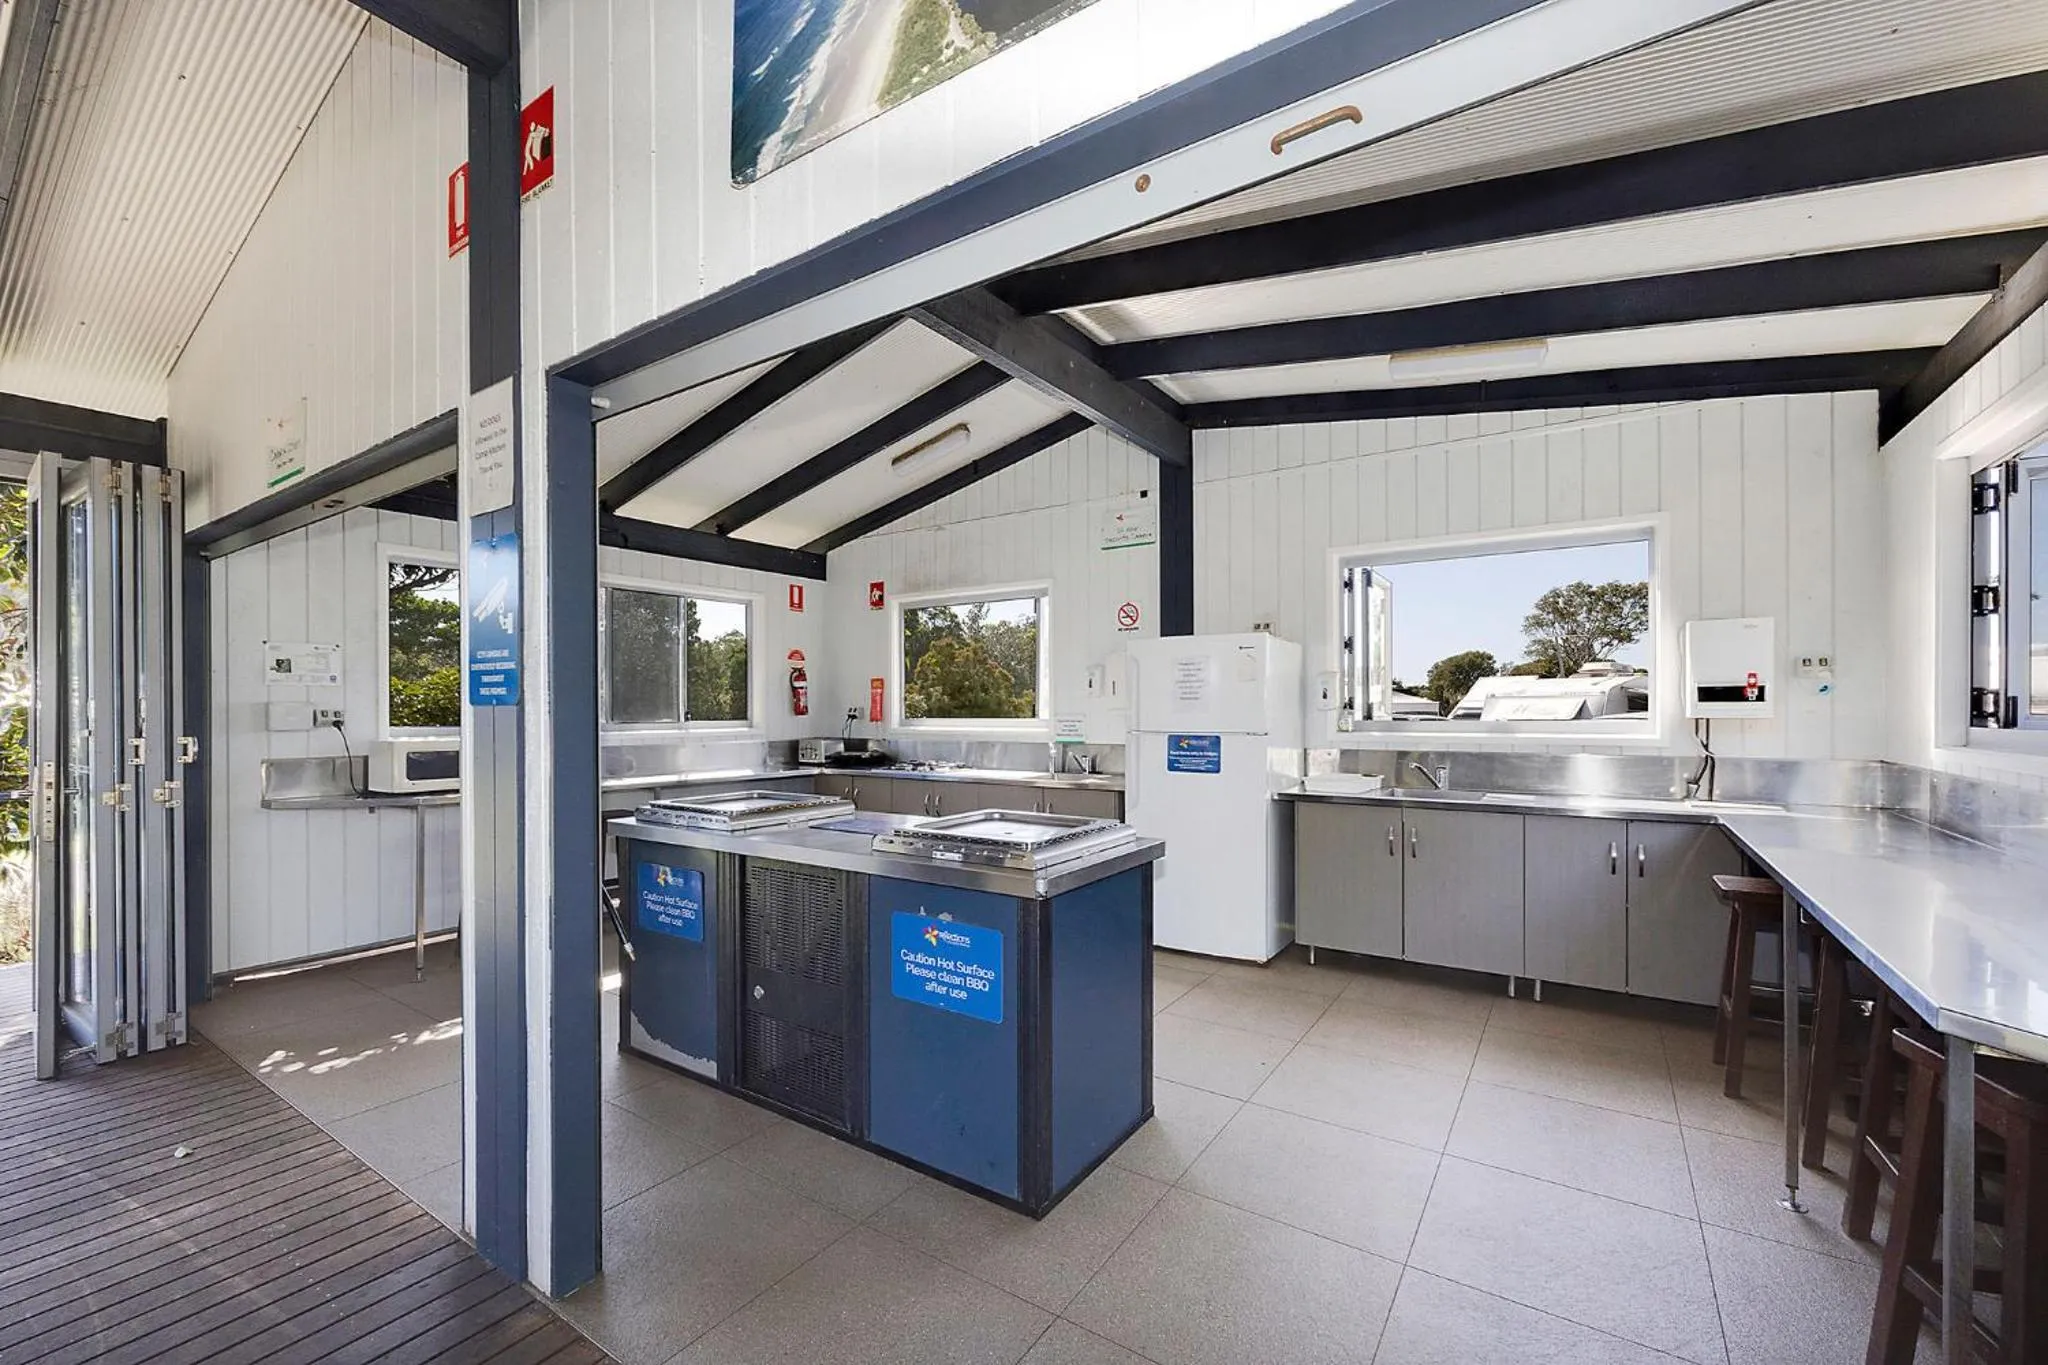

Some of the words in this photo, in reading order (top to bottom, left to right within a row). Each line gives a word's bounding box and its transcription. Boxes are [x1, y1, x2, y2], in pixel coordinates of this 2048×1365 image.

[901, 949, 936, 966] Caution
[937, 956, 955, 971] Hot
[956, 961, 995, 979] Surface
[905, 963, 937, 979] Please
[938, 971, 965, 986] clean
[966, 976, 990, 992] BBQ
[925, 981, 948, 995] after
[949, 987, 968, 1000] use
